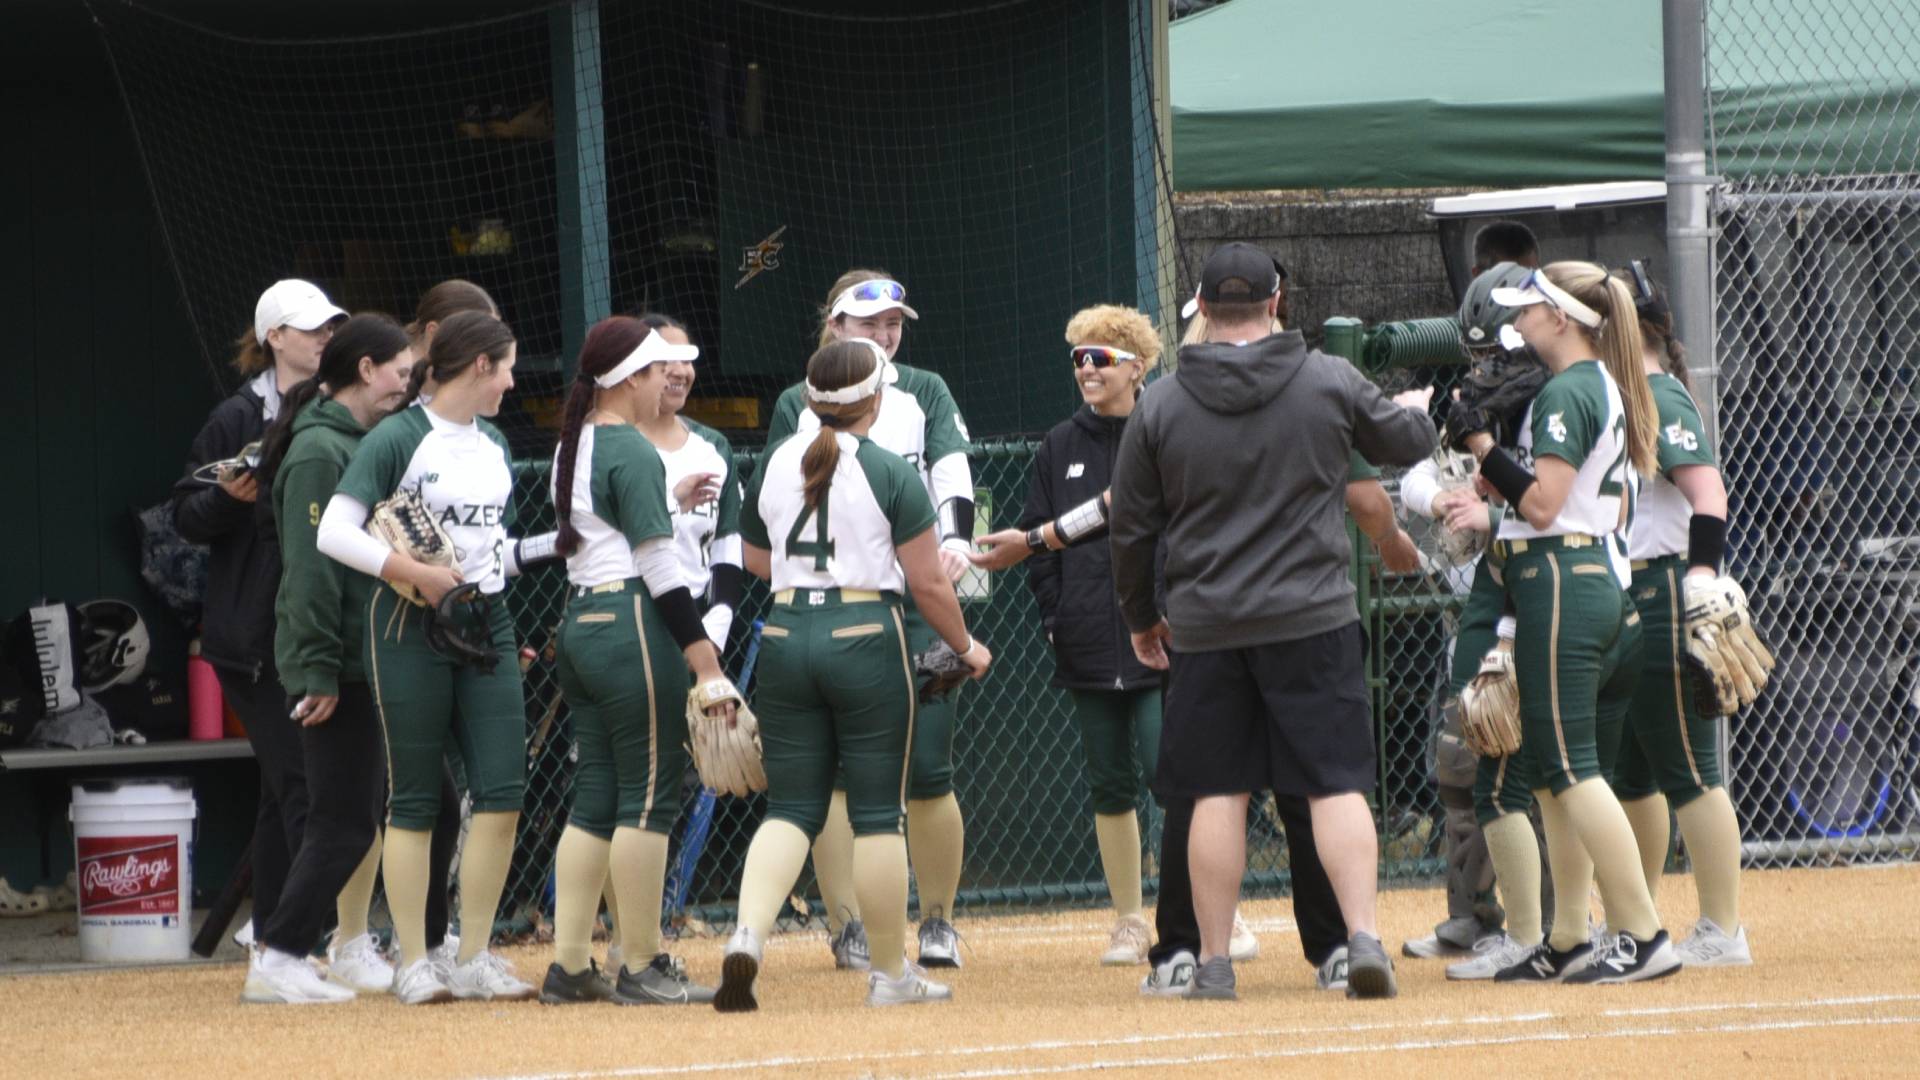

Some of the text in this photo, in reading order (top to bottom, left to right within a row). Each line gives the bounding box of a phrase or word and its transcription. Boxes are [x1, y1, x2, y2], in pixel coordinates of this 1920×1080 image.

[1666, 419, 1698, 451] EC
[309, 502, 320, 526] 9
[785, 482, 835, 572] 4
[83, 854, 172, 896] Rawlings
